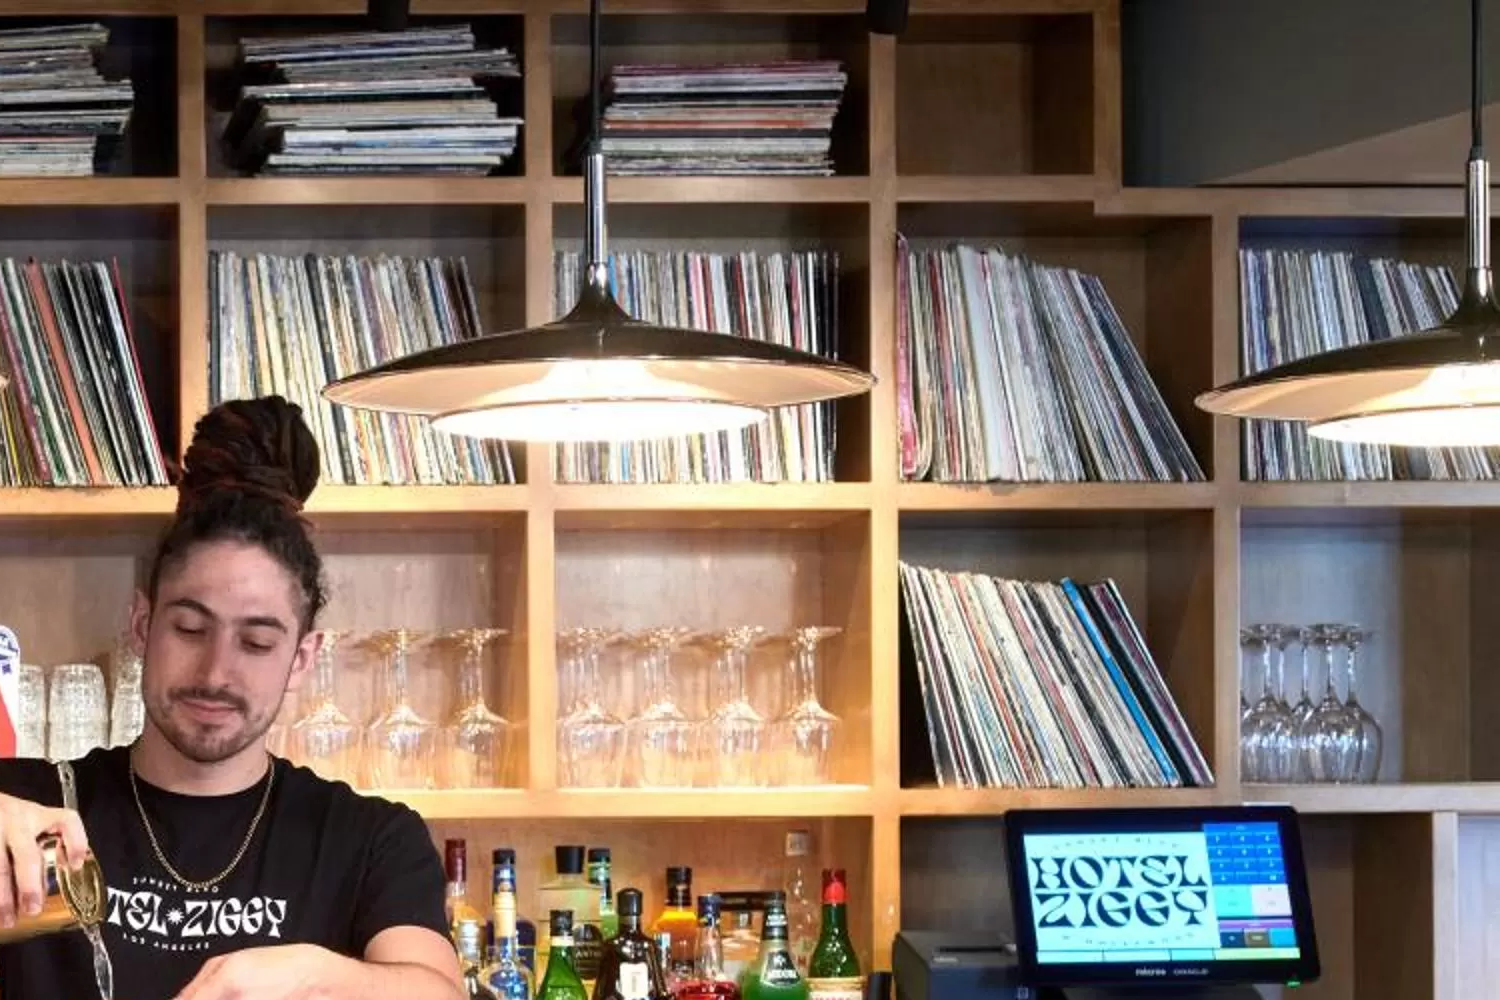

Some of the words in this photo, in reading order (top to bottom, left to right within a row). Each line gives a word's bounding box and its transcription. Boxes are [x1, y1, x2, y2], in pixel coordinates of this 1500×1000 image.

[133, 877, 178, 892] SUNSET
[1030, 855, 1208, 889] HOTEL
[107, 886, 169, 937] TEL
[181, 896, 288, 938] ZIGGY
[1035, 890, 1208, 929] ZIGGY
[123, 932, 146, 945] LOS
[153, 941, 210, 951] ANGELES
